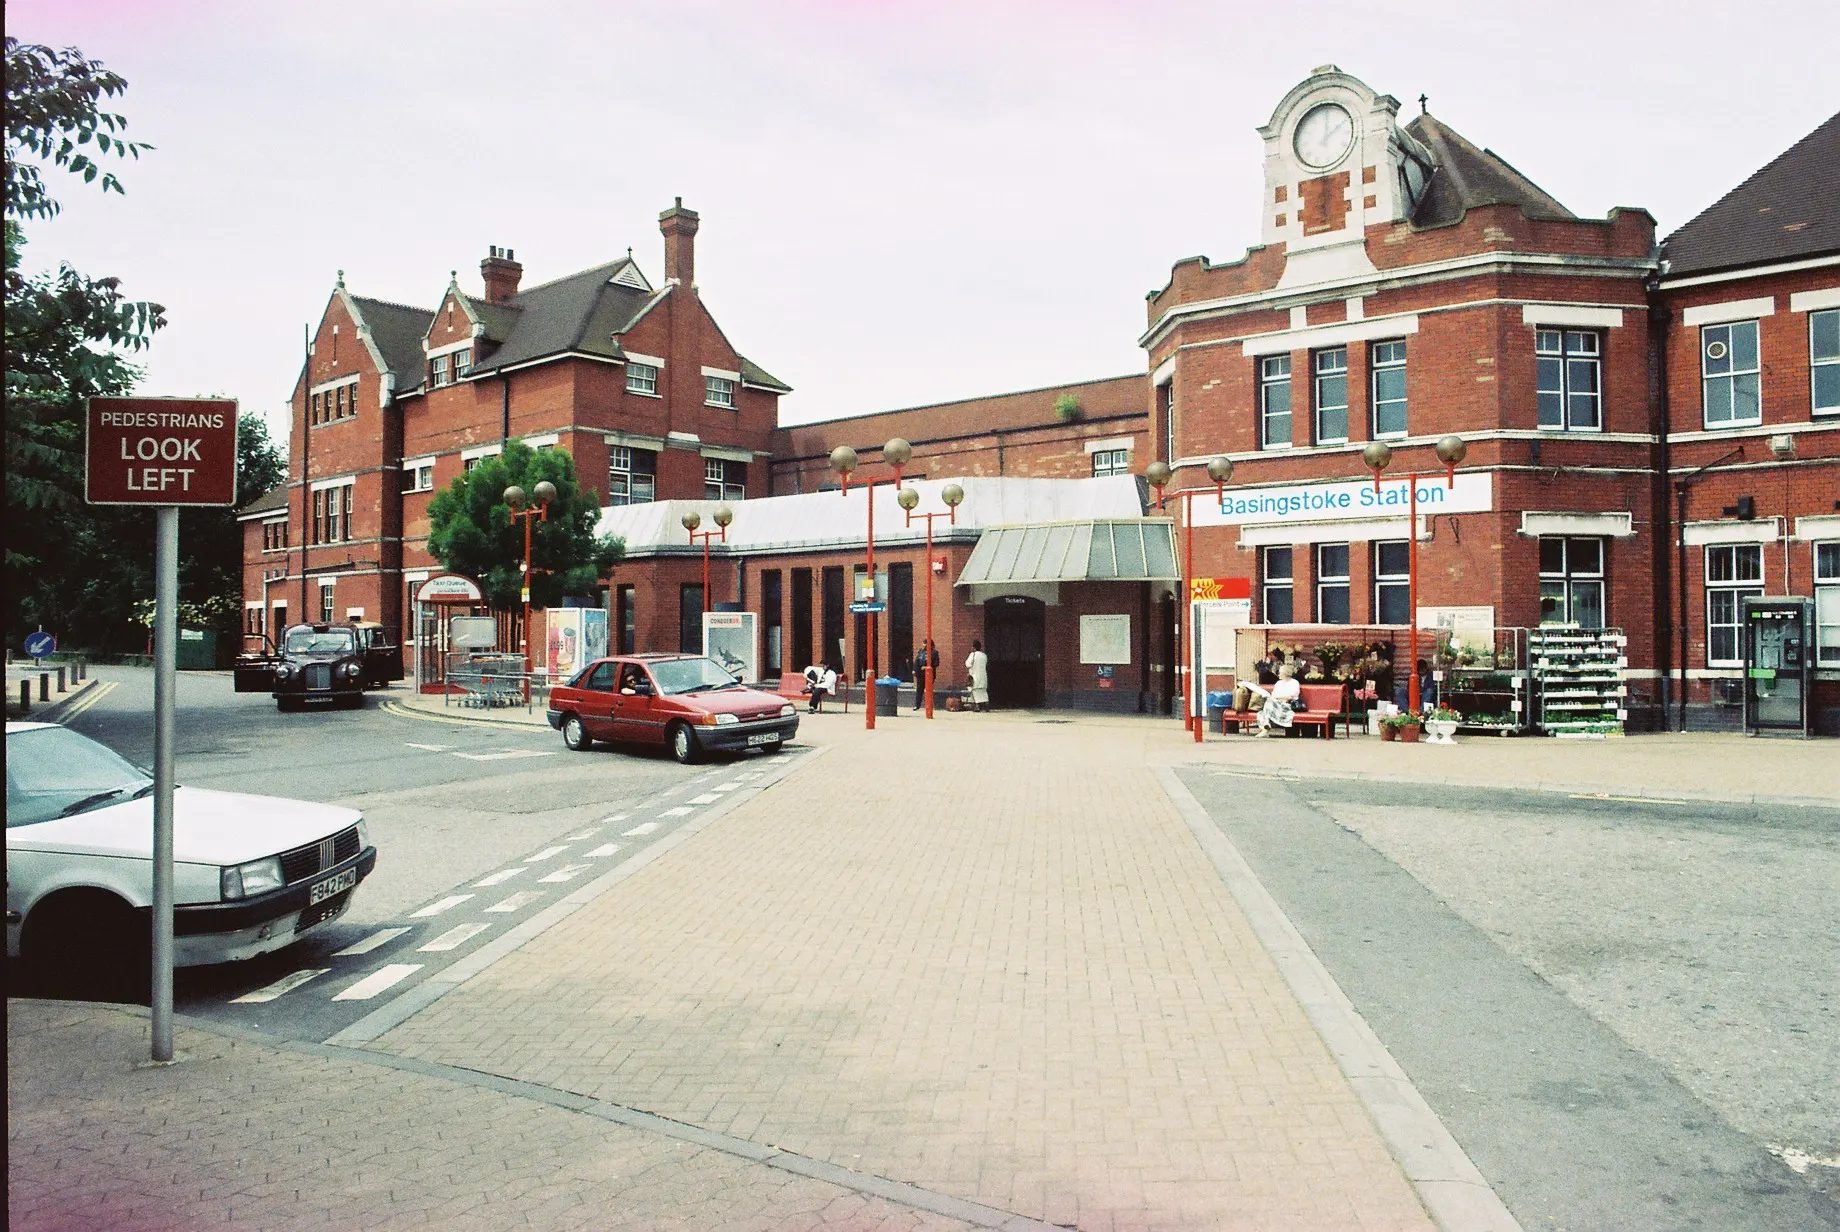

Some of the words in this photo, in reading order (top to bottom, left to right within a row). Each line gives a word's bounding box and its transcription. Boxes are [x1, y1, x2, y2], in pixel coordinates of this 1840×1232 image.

[101, 411, 224, 428] PEDESTRIANS
[121, 437, 202, 461] LOOK
[127, 467, 195, 491] LEFT
[1221, 490, 1350, 515] Basingstoke
[1360, 485, 1444, 506] Staton
